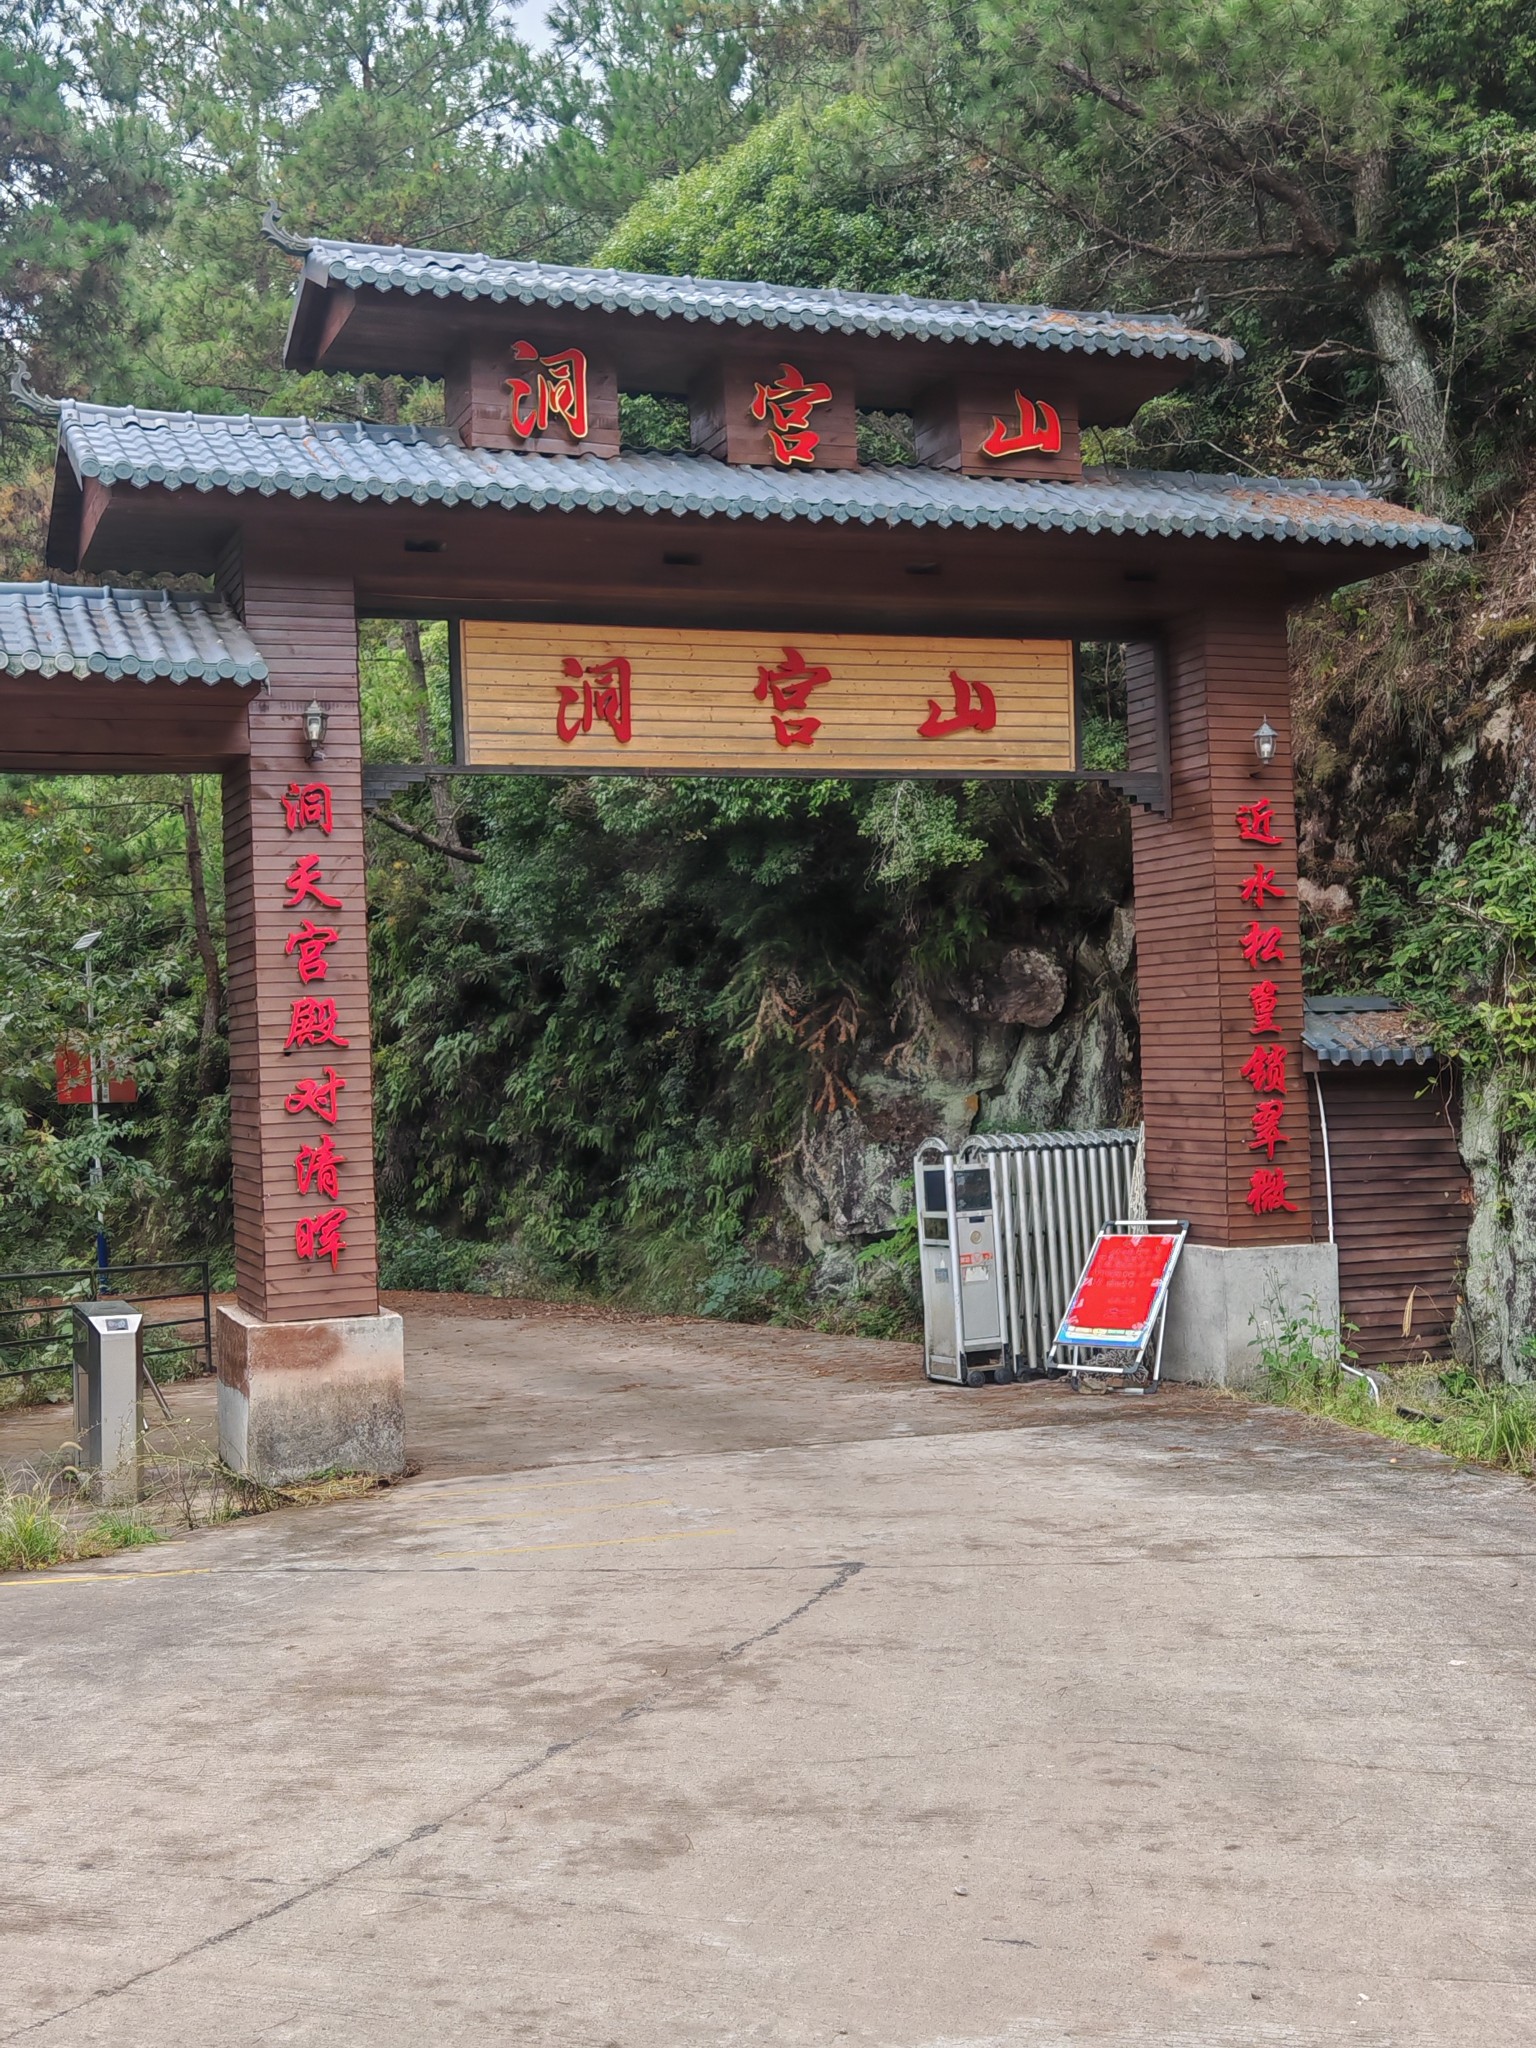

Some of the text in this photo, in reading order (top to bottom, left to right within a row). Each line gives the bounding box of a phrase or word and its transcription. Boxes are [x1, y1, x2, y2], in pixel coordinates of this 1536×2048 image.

[505, 340, 1062, 466] 洞宫山
[556, 647, 998, 749] 洞宫山
